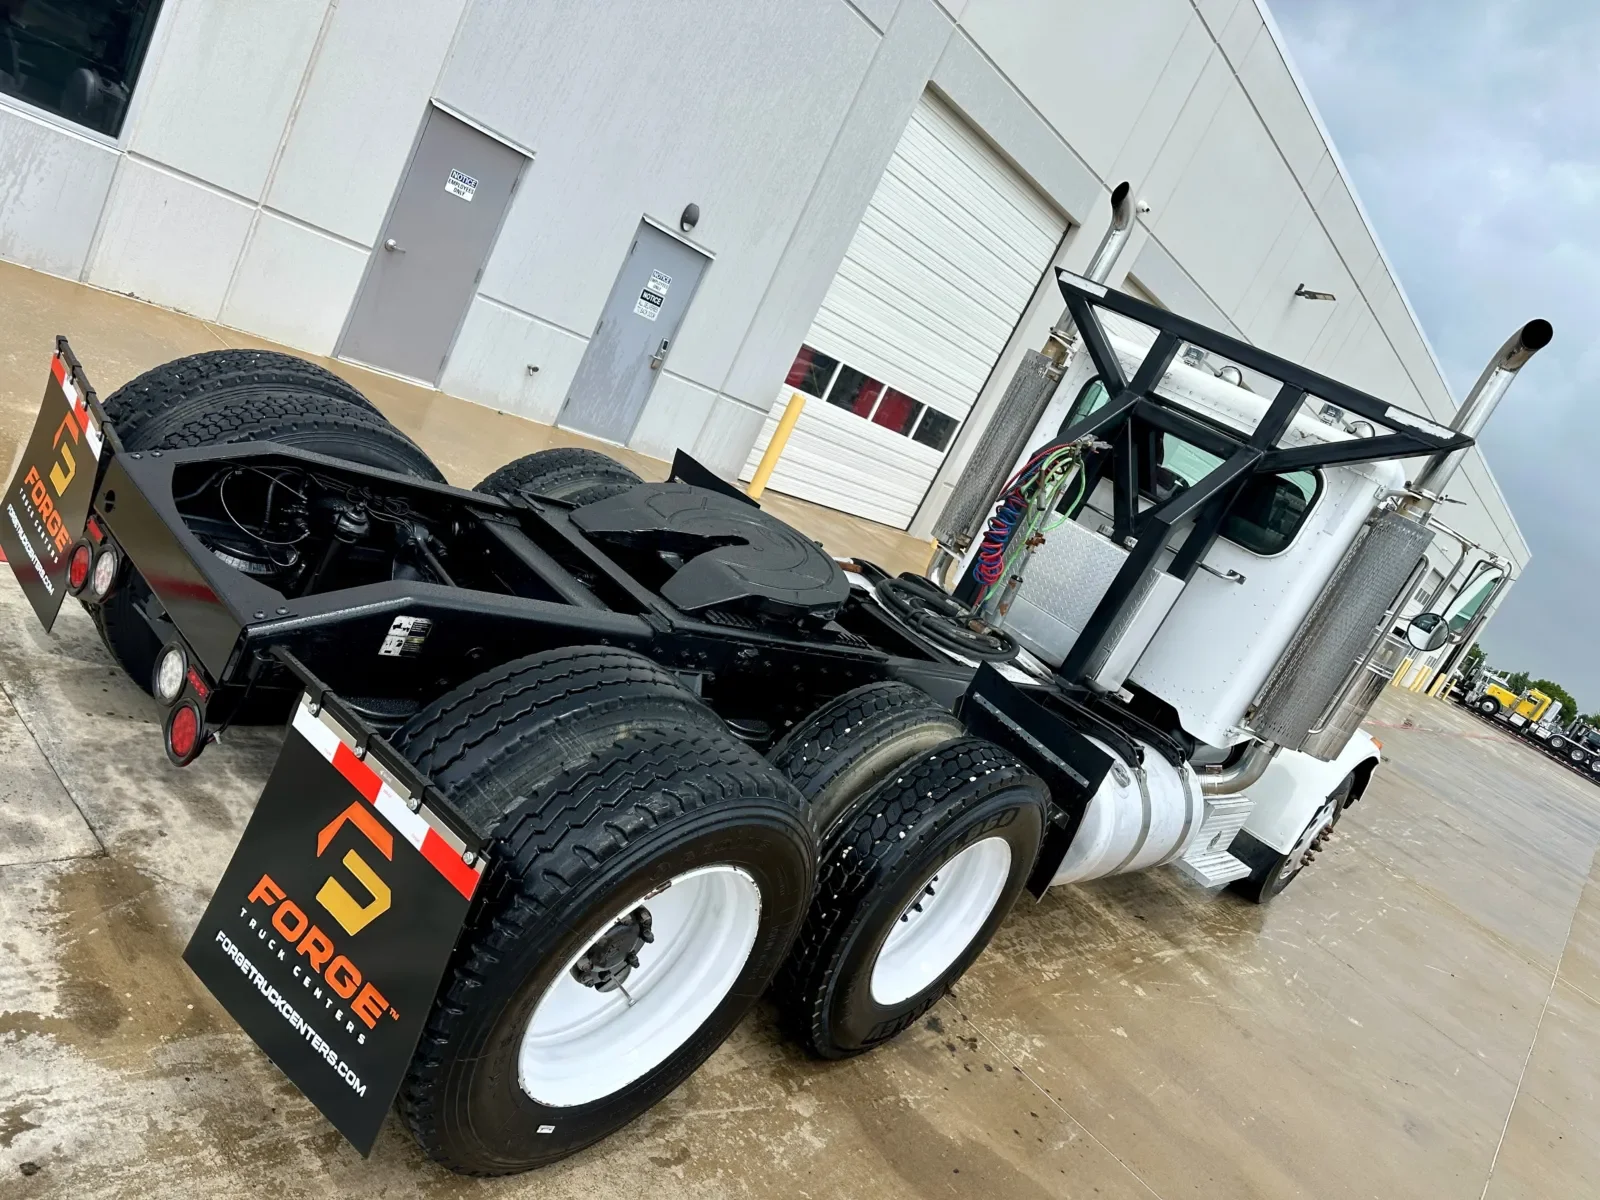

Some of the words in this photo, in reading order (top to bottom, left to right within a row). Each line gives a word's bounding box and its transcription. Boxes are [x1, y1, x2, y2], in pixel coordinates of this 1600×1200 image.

[448, 179, 475, 194] EMPLOYEES
[451, 170, 478, 188] NOTICE
[453, 187, 465, 196] ONLY
[642, 292, 662, 305] NOTICE
[652, 270, 671, 284] NOTICE
[19, 487, 35, 519] TRUCK
[34, 519, 58, 564] CENTERS
[24, 465, 64, 553] FORGE
[7, 503, 55, 596] FORGETRUCKCENTERS.COM
[240, 907, 286, 961] TRUCK
[293, 965, 366, 1045] CENTERS
[247, 875, 390, 1029] FORGE
[215, 930, 367, 1098] FORGETRUCKCENTERS.COM
